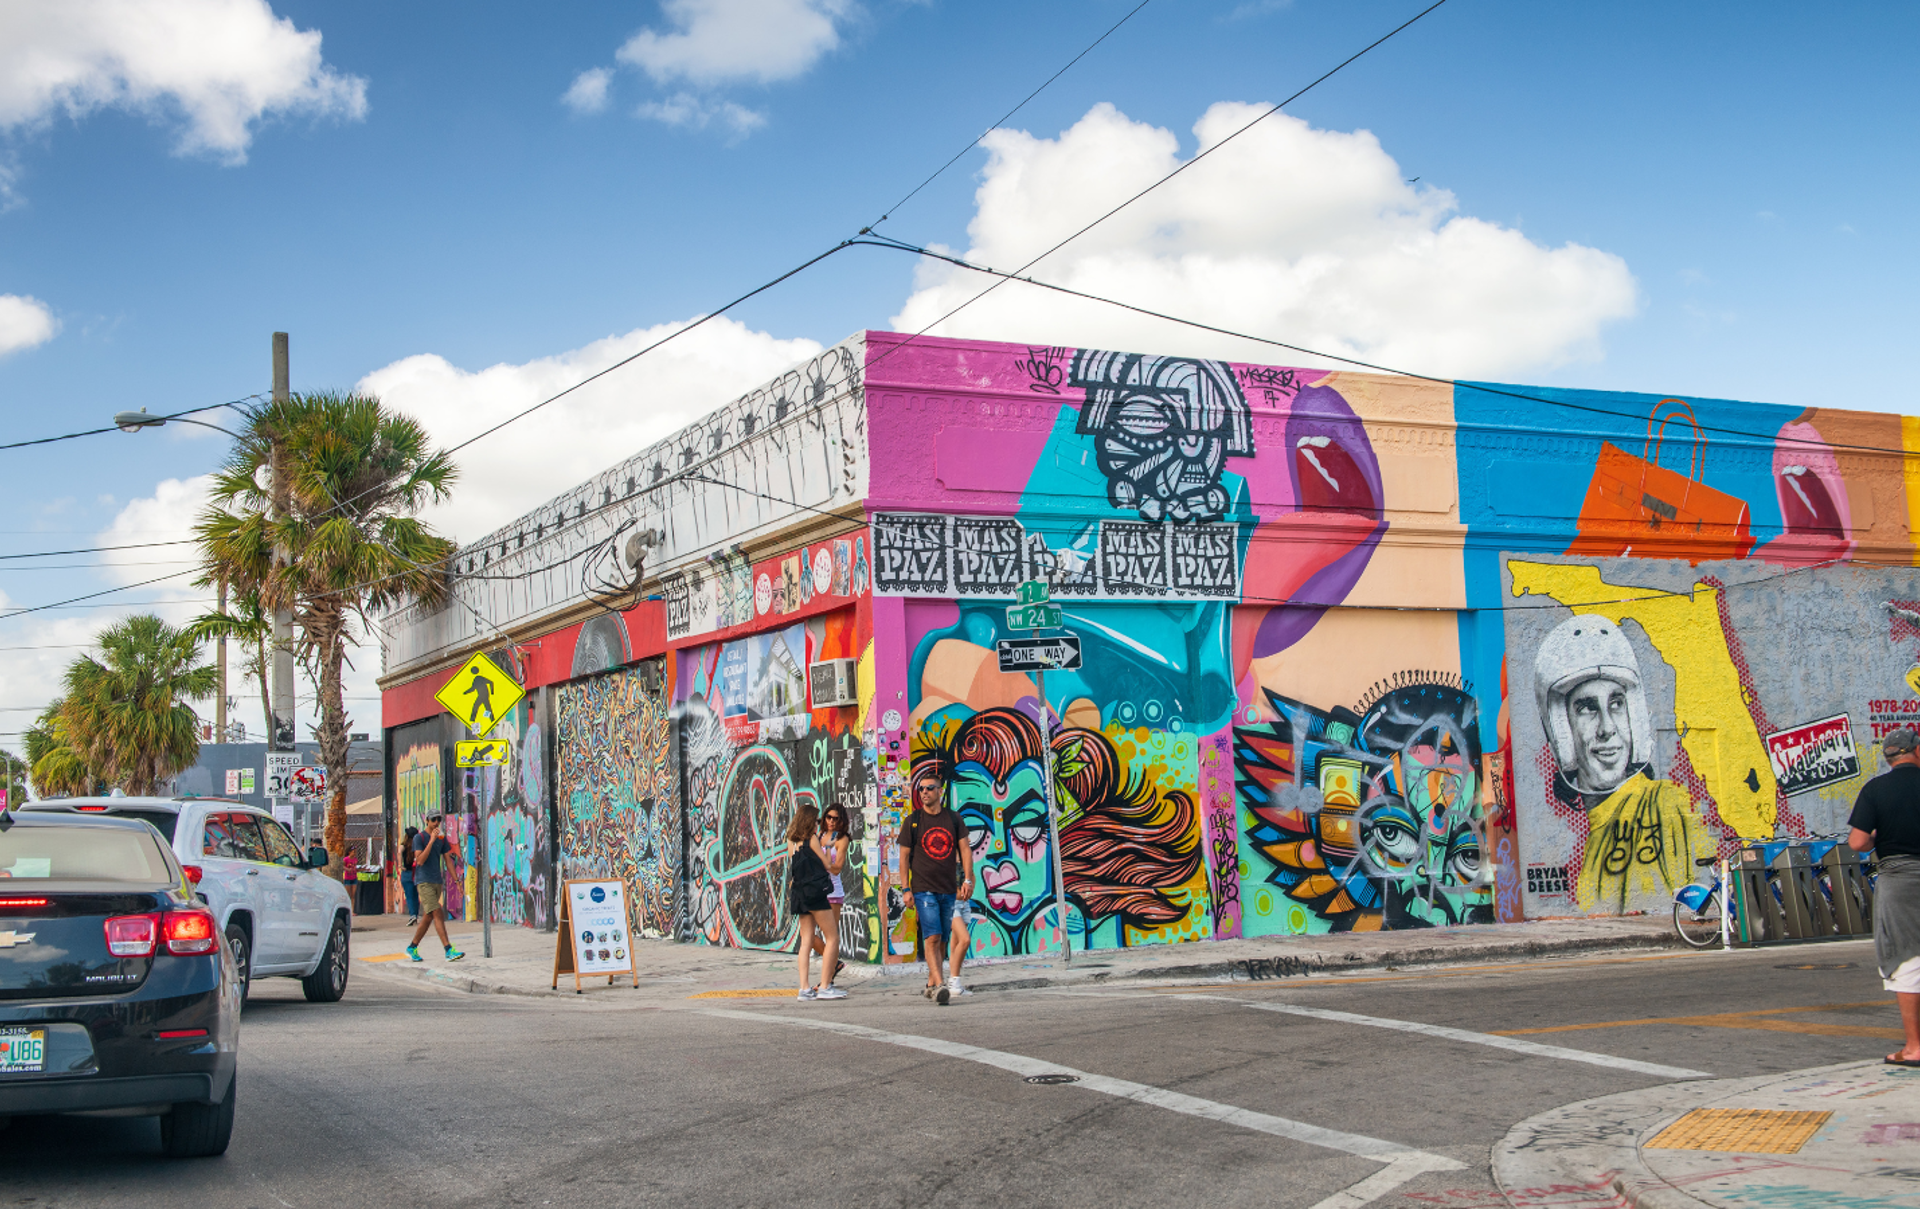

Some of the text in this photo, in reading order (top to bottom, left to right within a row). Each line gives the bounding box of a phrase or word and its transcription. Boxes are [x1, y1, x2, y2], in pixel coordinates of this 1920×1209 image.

[879, 523, 942, 550] MAS
[957, 526, 1018, 553] MAS
[1105, 531, 1162, 555] MAS
[1175, 532, 1231, 557] MAS
[880, 549, 943, 581] PAZ
[957, 552, 1020, 584] PAZ
[1106, 554, 1164, 585] PAZ
[1175, 556, 1232, 587] PAZ
[1009, 608, 1061, 627] NW 24 ST
[1013, 648, 1035, 662] ONE
[1044, 647, 1066, 660] WAY
[268, 757, 300, 765] SPEED
[1773, 721, 1852, 784] Skateboard
[271, 766, 288, 774] LIM
[1817, 756, 1850, 778] USA
[1527, 866, 1568, 880] BRYAN
[1528, 880, 1570, 893] DEESE
[85, 974, 124, 983] MALIBU
[10, 1040, 42, 1061] U86
